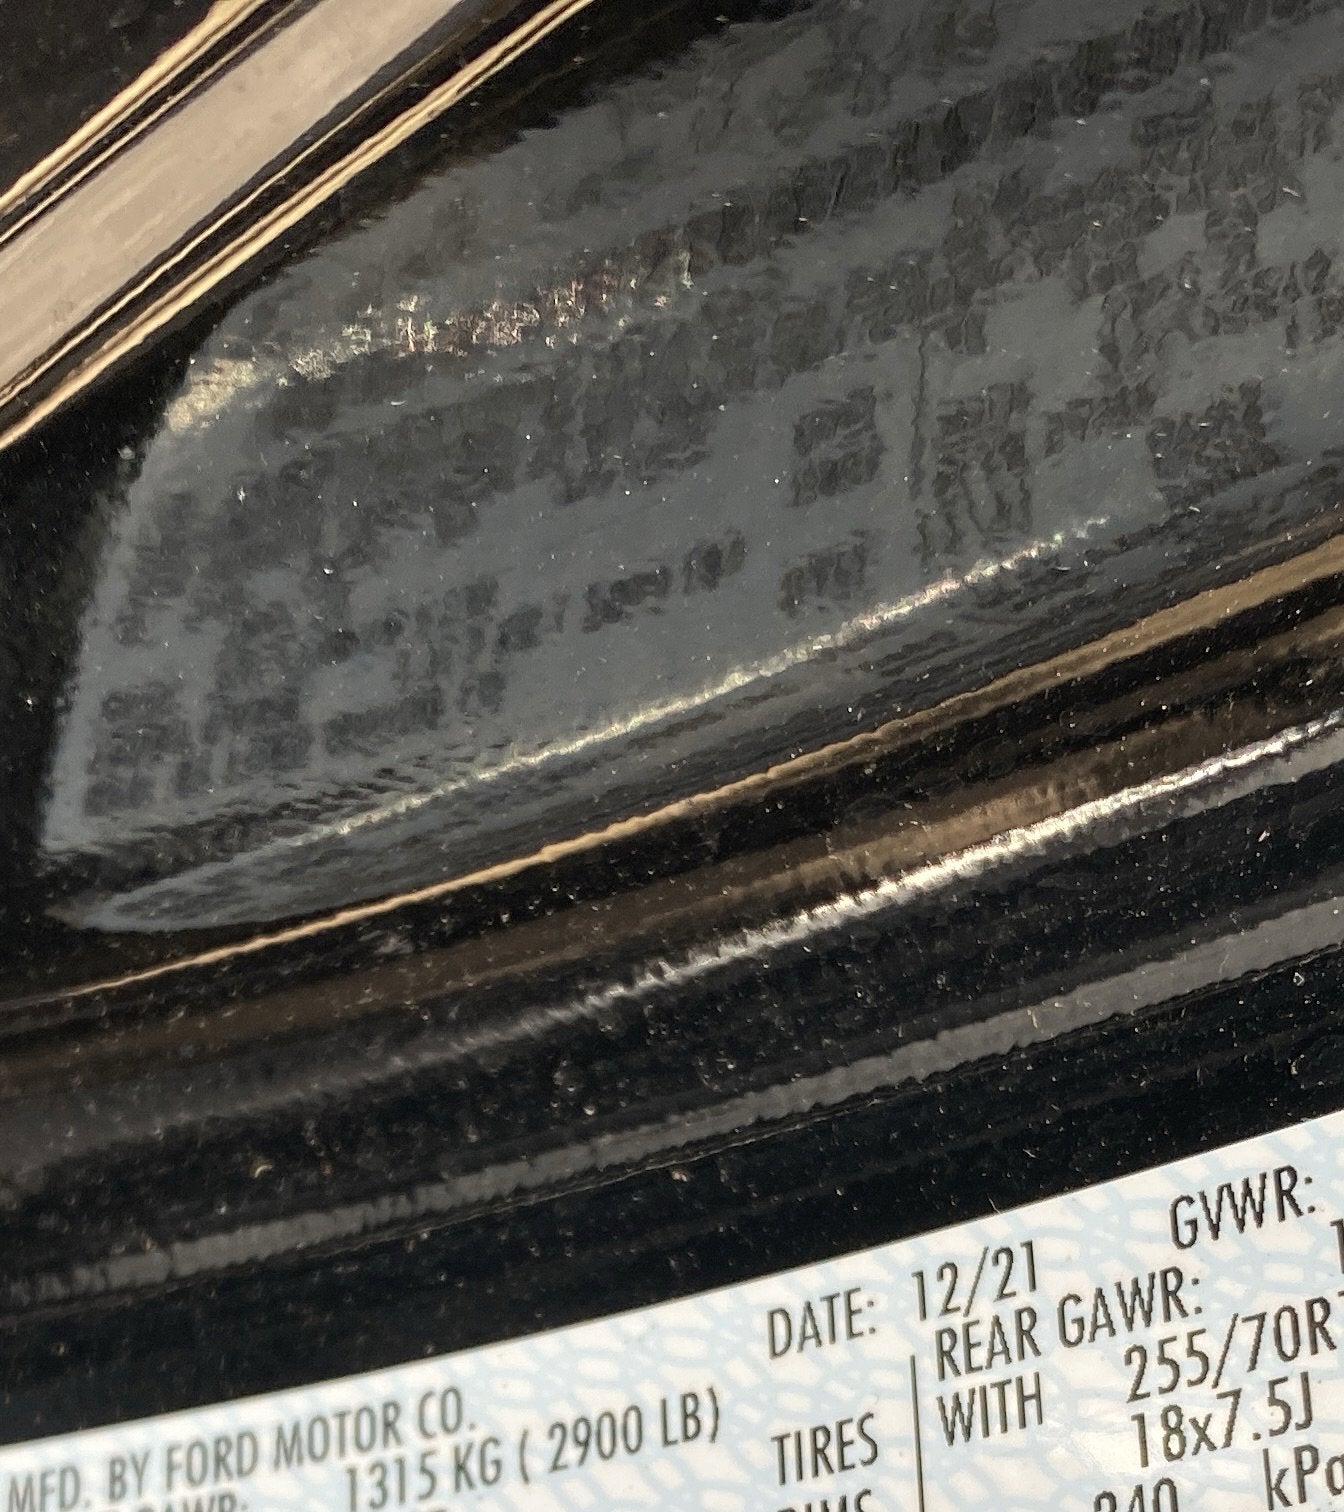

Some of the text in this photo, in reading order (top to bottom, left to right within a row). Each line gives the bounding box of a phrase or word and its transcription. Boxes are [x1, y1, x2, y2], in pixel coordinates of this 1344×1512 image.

[1170, 1165, 1315, 1249] GVWR:
[767, 1241, 1037, 1359] DATE: 12/21
[935, 1307, 1042, 1381] REAR
[1057, 1266, 1202, 1349] GAWR:
[109, 1453, 151, 1499] BY
[166, 1432, 256, 1490] FORD
[274, 1399, 401, 1470] MOTOR
[418, 1387, 476, 1438] CO.
[454, 1438, 503, 1492] KG
[548, 1405, 644, 1473] 2900
[661, 1387, 722, 1448] LB)
[771, 1413, 879, 1485] TIRES
[937, 1372, 1043, 1446] WITH
[1132, 1371, 1313, 1467] 18x7.5J
